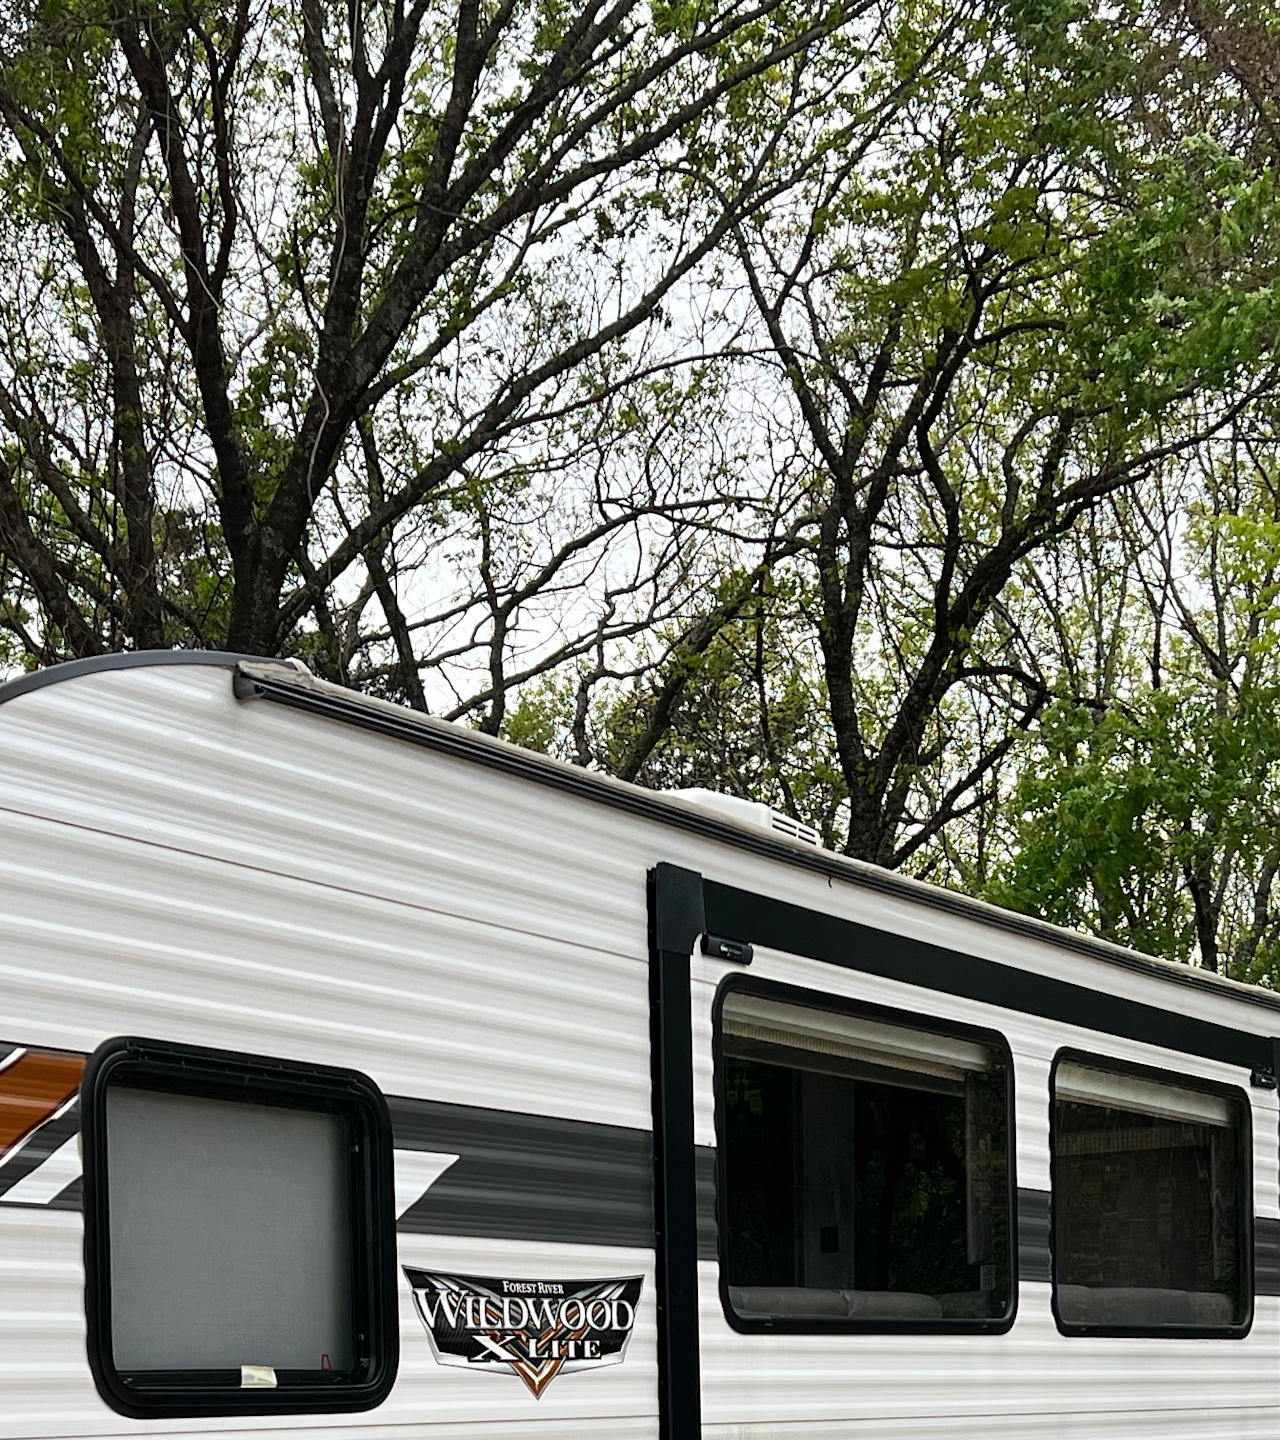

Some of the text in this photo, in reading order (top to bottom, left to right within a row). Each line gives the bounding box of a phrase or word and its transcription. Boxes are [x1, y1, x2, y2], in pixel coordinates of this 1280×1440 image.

[502, 1280, 564, 1295] FOREST RIVER
[413, 1287, 635, 1332] WILDWOOD
[468, 1335, 602, 1362] X LITE
